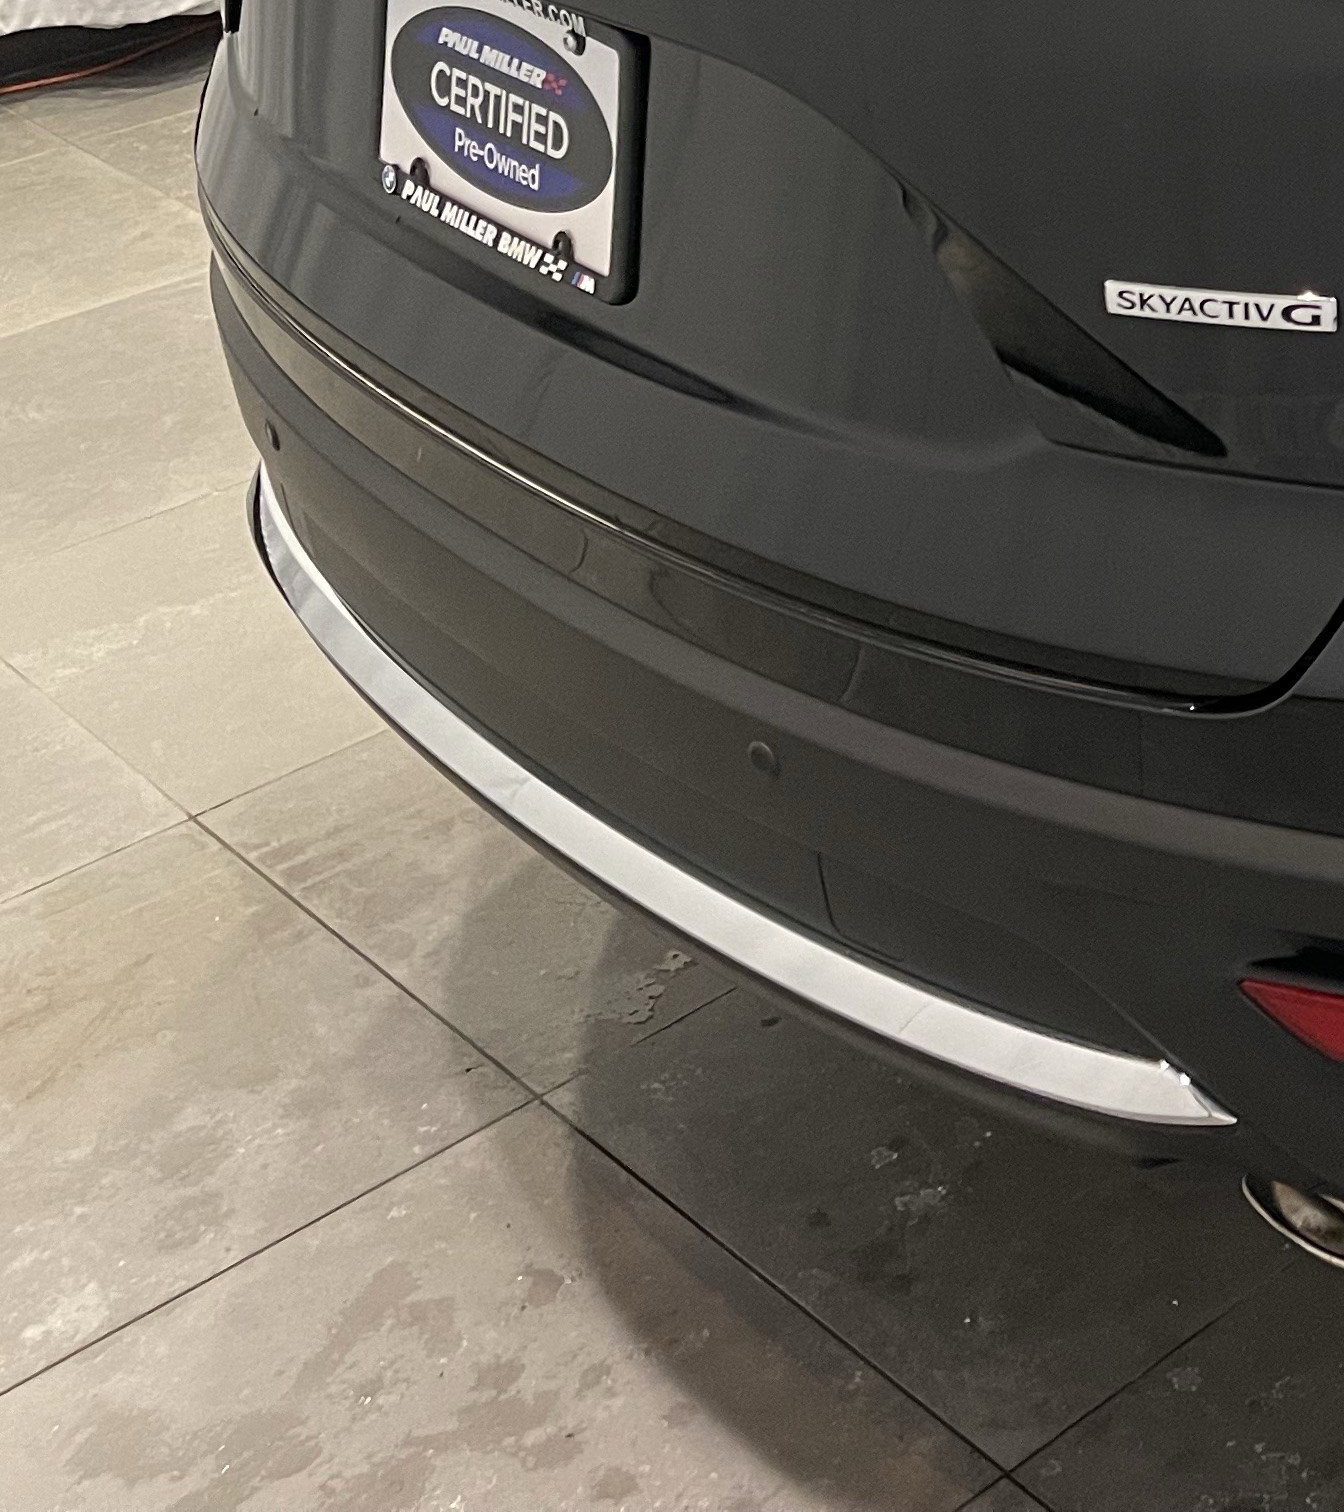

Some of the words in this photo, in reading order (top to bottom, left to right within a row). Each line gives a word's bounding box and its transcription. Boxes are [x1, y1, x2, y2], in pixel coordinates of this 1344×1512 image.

[438, 27, 480, 59] PAUL
[479, 45, 547, 89] MILLER
[430, 61, 570, 160] CERTIFIED
[454, 127, 540, 191] Pre-Owned
[401, 179, 440, 217] PAUL
[440, 201, 498, 247] MILLER
[497, 231, 543, 269] BMW
